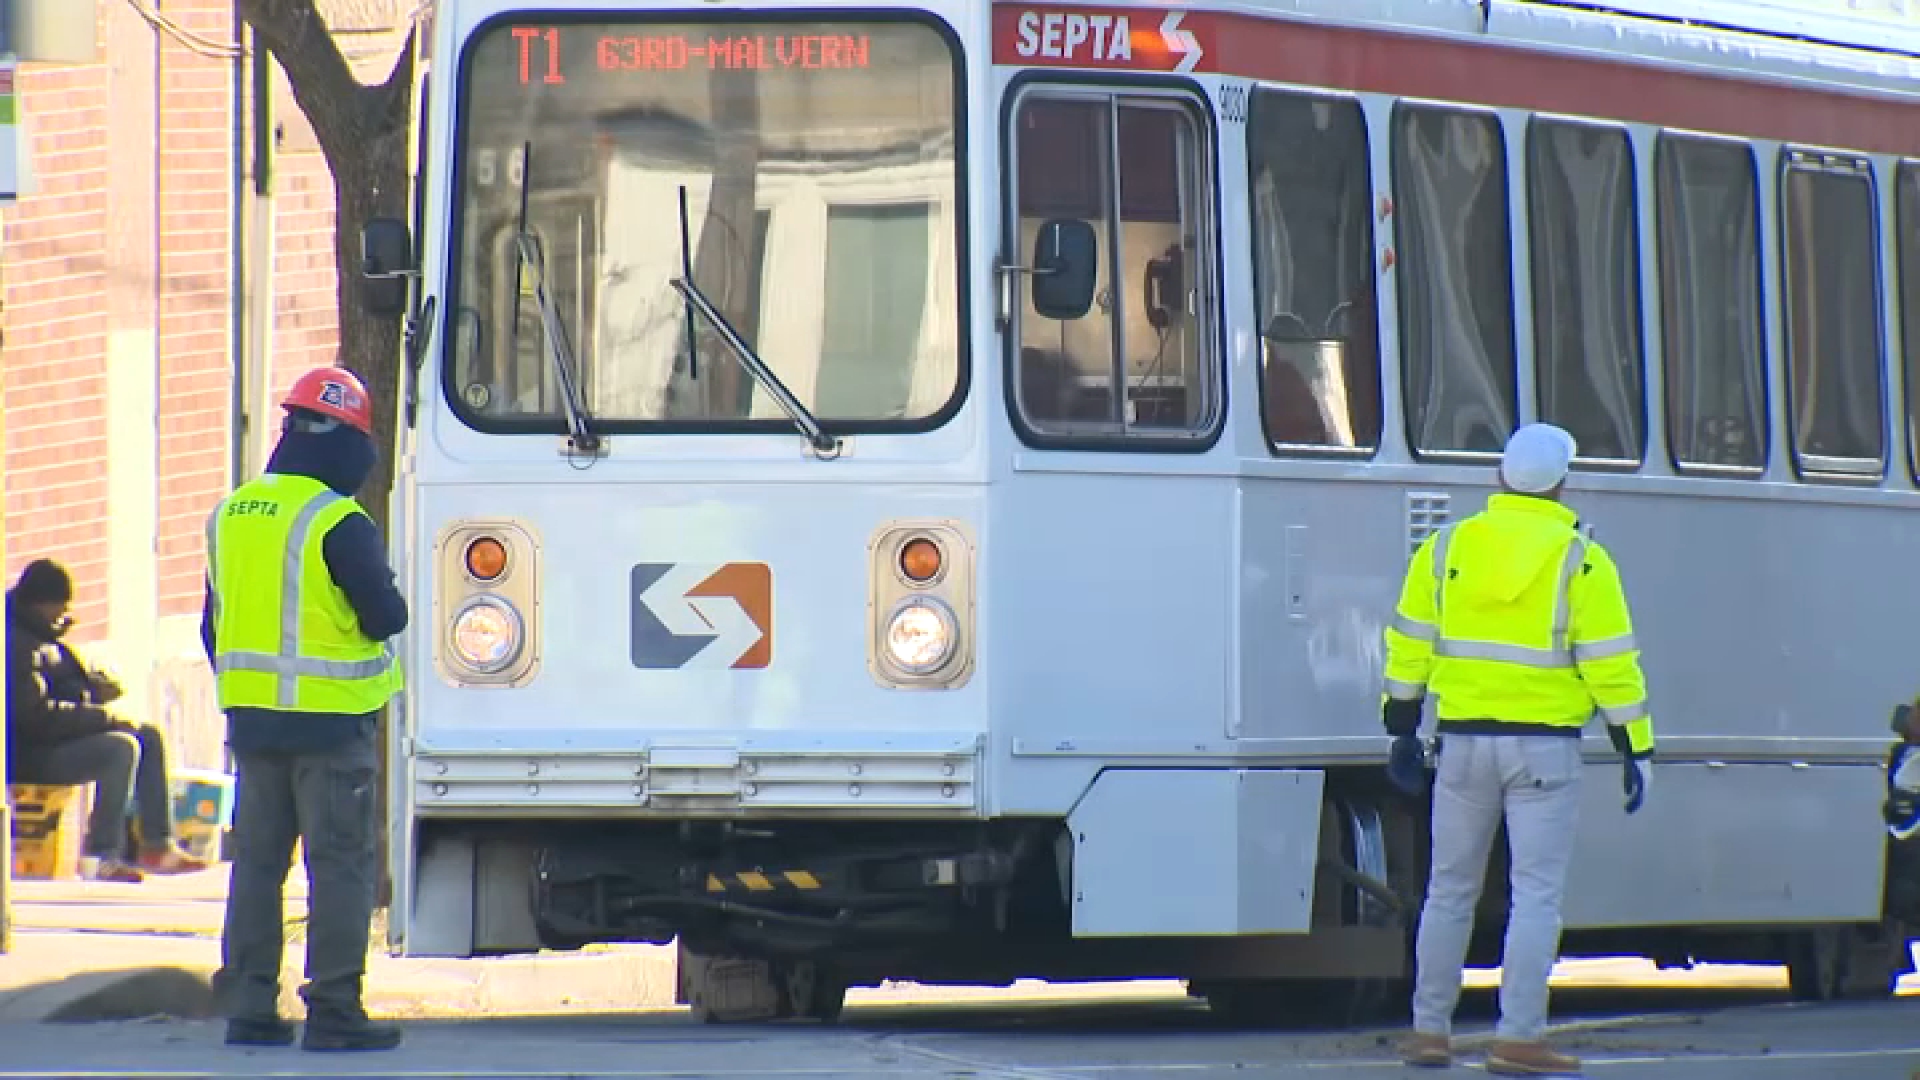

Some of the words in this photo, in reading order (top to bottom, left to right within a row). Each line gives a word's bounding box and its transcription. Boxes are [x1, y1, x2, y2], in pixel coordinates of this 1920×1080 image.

[512, 27, 565, 84] T1
[597, 36, 869, 69] 63RD-MALVERN
[1016, 11, 1131, 60] SEPTA
[227, 500, 277, 517] SEPTA
